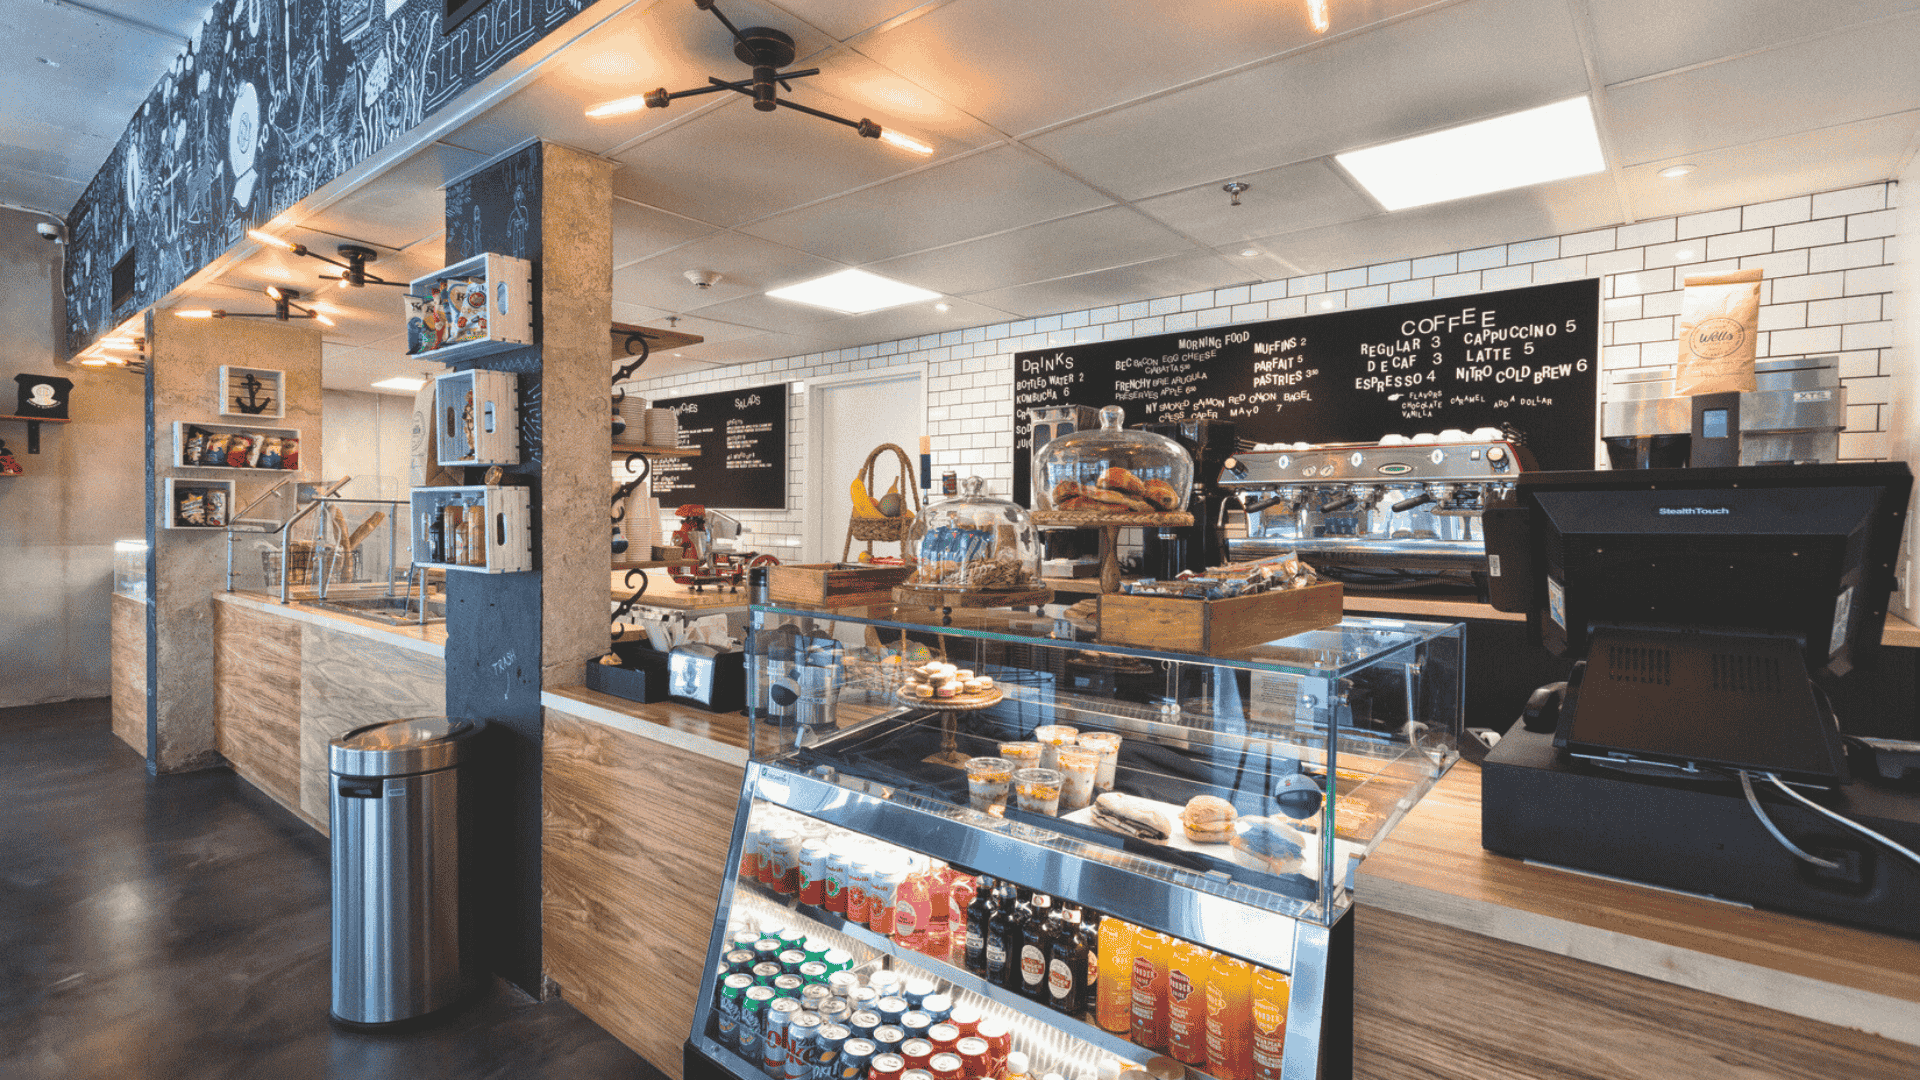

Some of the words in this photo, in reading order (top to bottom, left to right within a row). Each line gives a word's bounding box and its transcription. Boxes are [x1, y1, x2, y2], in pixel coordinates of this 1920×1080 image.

[426, 29, 470, 96] STEP
[1401, 307, 1496, 337] COFFEE
[1178, 336, 1222, 351] MORNING
[1224, 331, 1250, 346] FOOD
[1463, 323, 1557, 346] CAPPUCCINO
[1565, 319, 1577, 333] 5
[1254, 337, 1297, 355] MUFFINS
[1300, 337, 1307, 347] 2
[1360, 338, 1421, 358] REGULAR
[1430, 335, 1441, 348] 3
[1466, 347, 1512, 363] LATTE
[1524, 341, 1535, 355] 5
[1022, 352, 1075, 375] DRINKS
[1115, 357, 1132, 371] BEC
[1133, 357, 1159, 368] BACON
[1162, 353, 1180, 363] EGG
[1181, 348, 1217, 362] CHEESE
[1254, 357, 1294, 373] PARFAIT
[1297, 354, 1304, 363] 5
[1432, 352, 1443, 365] 3
[1253, 370, 1303, 389] PASTRIES
[1456, 365, 1493, 383] NITRO
[1495, 365, 1531, 383] COLD
[1533, 362, 1572, 385] BREW
[1576, 358, 1588, 372] 6
[1016, 376, 1047, 391] BOTTLED
[1048, 373, 1074, 387] WATER
[1079, 372, 1085, 382] 2
[1115, 378, 1152, 392] FRENCHY
[1355, 372, 1423, 393] ESPRESSO
[1426, 370, 1437, 383] 4
[1016, 388, 1058, 405] KOMBUCHA
[1063, 386, 1070, 397] 6
[1160, 386, 1183, 397] APPLE
[1409, 390, 1442, 400] FLAVORS
[734, 394, 761, 410] SALADS
[1145, 402, 1157, 414] NY
[1158, 399, 1190, 412] SMOKED
[1193, 397, 1225, 411] SALMON
[1228, 393, 1246, 405] RED
[1248, 391, 1277, 404] ONION
[1283, 389, 1313, 402] BAGEL
[1229, 405, 1259, 417] MAYO
[1276, 403, 1283, 412] 7
[1401, 400, 1442, 410] CHOCOLATE
[1450, 394, 1486, 406] CARAMEL
[1493, 400, 1509, 409] ADD
[1509, 395, 1516, 403] A
[1520, 395, 1553, 407] DOLLAR
[1401, 410, 1433, 419] VANILLA
[1659, 506, 1730, 515] StealthTouch
[491, 648, 517, 676] TRASH
